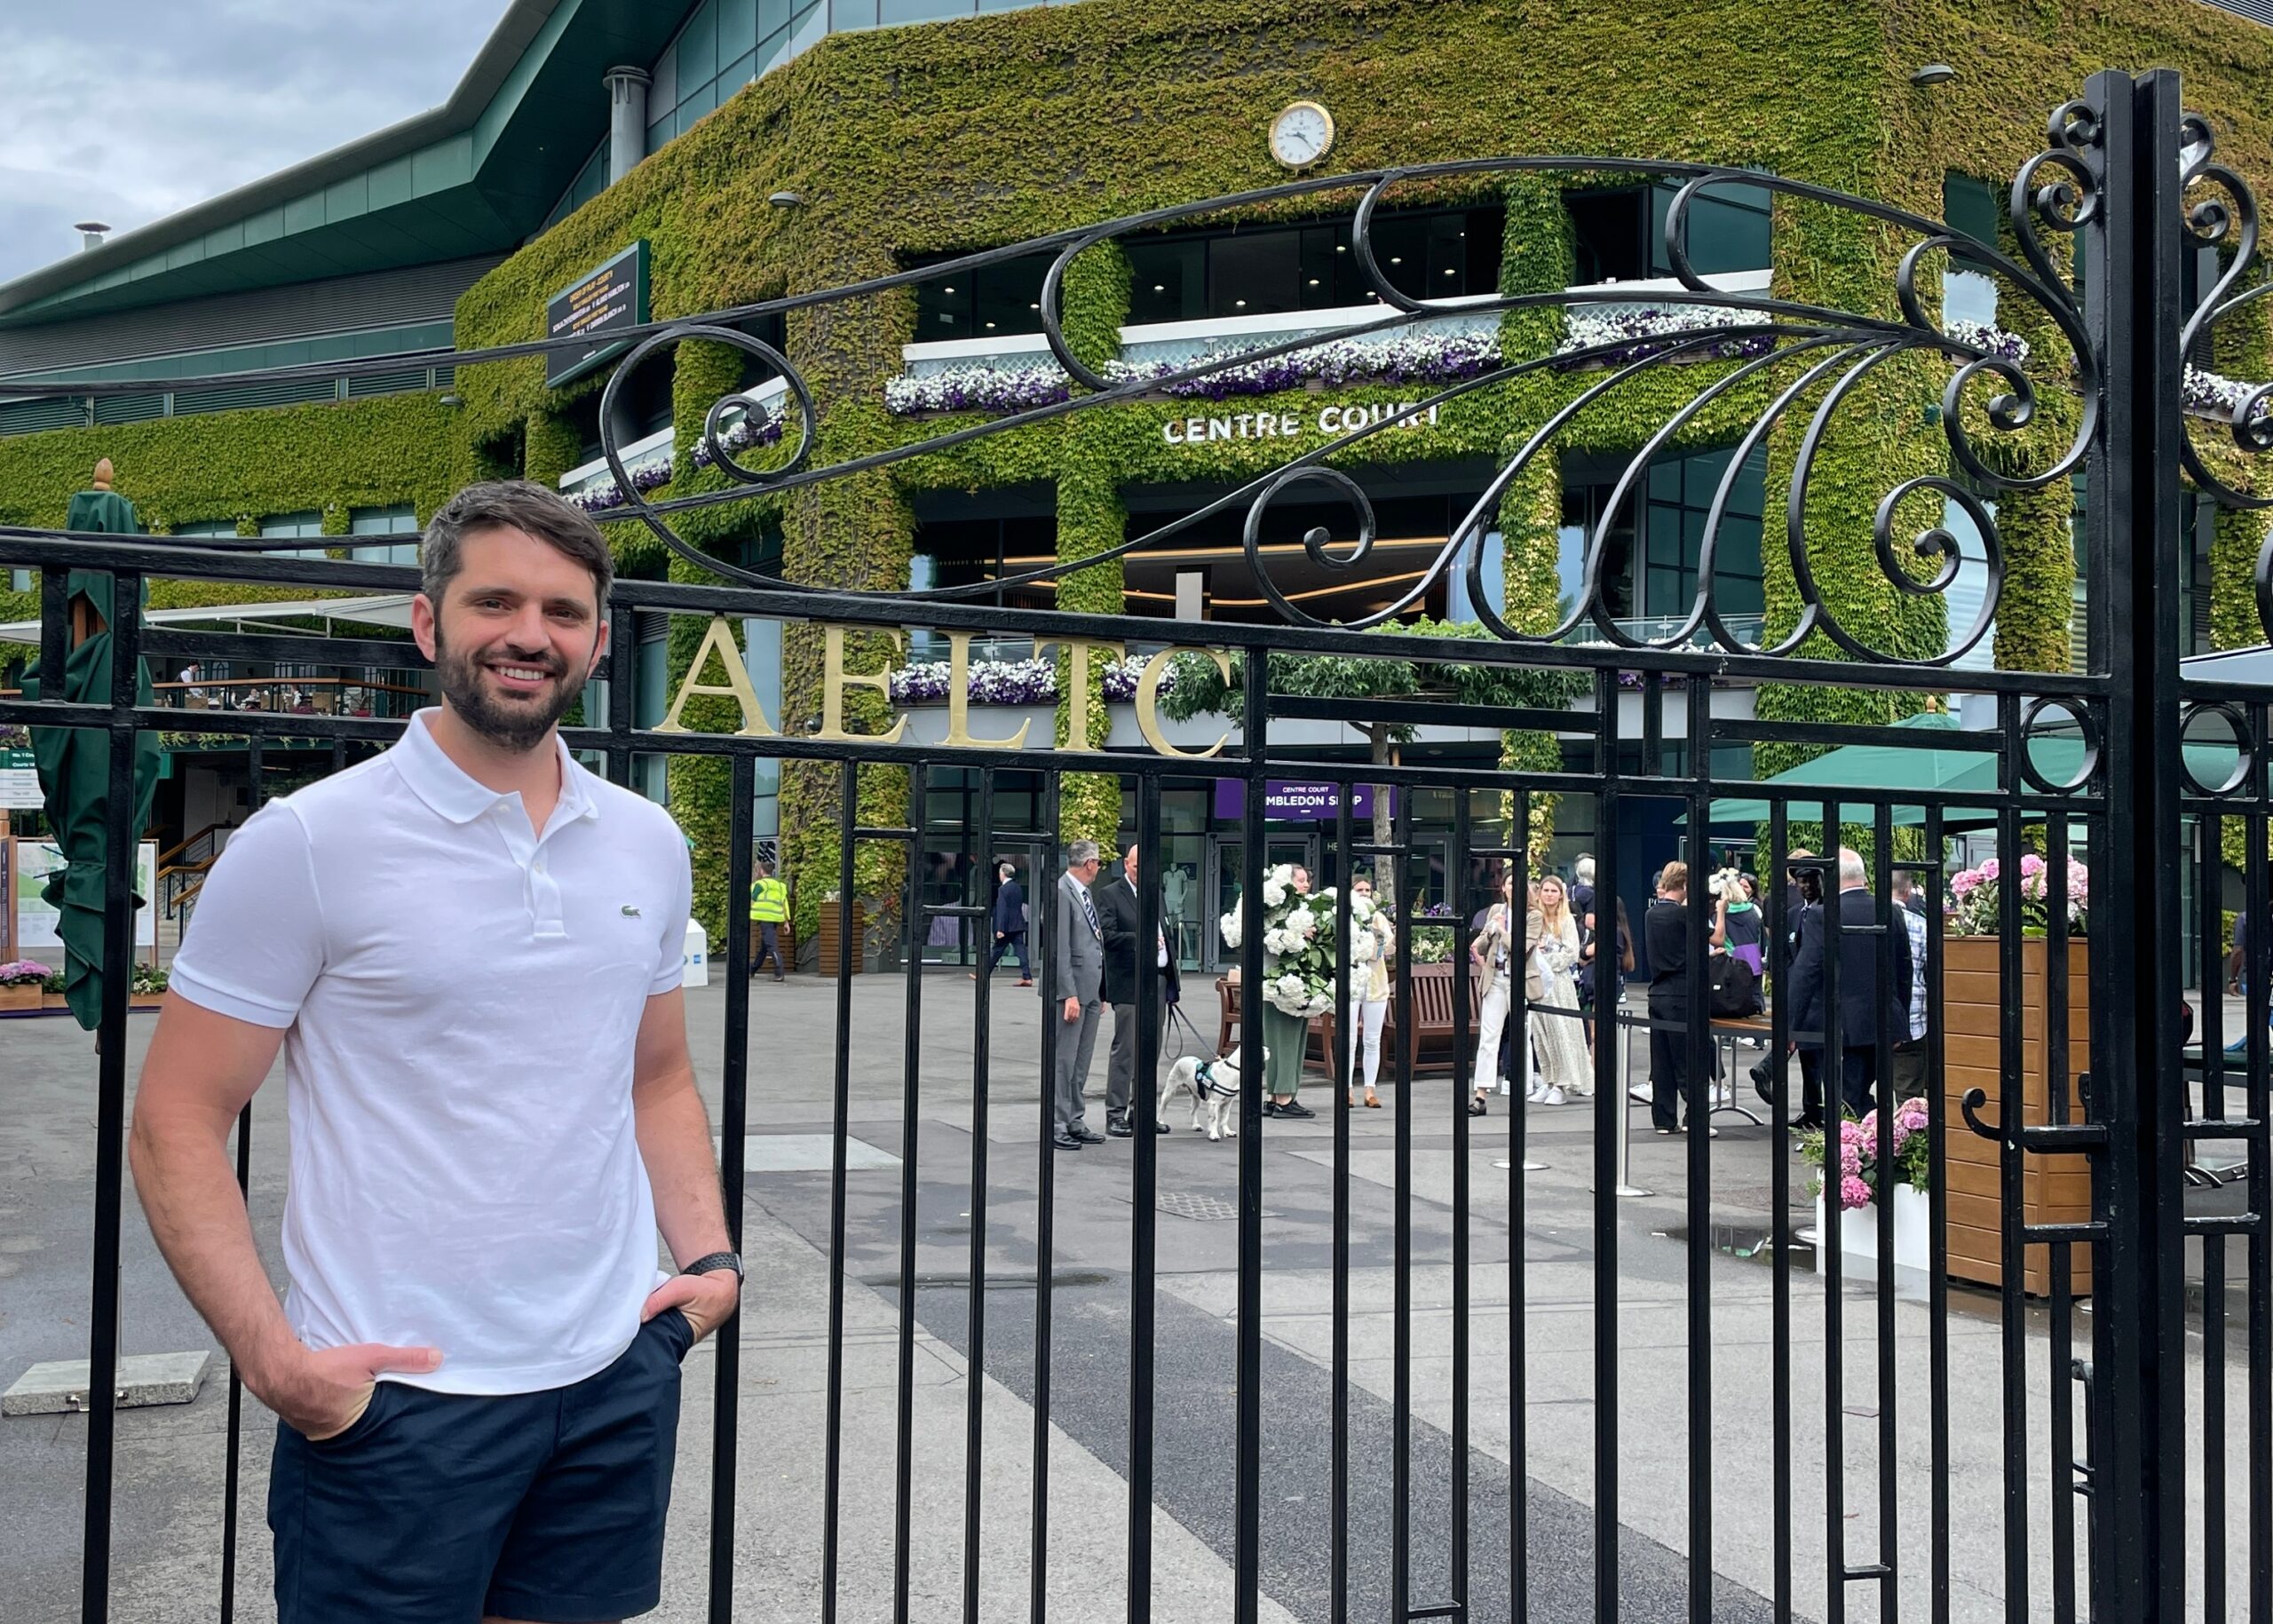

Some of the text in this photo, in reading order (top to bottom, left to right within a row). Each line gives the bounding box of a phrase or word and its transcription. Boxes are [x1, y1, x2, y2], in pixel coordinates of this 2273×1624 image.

[1163, 400, 1445, 444] CENTRE COURT
[651, 613, 1232, 757] AELTC
[1265, 795, 1363, 806] MBLEDON SP
